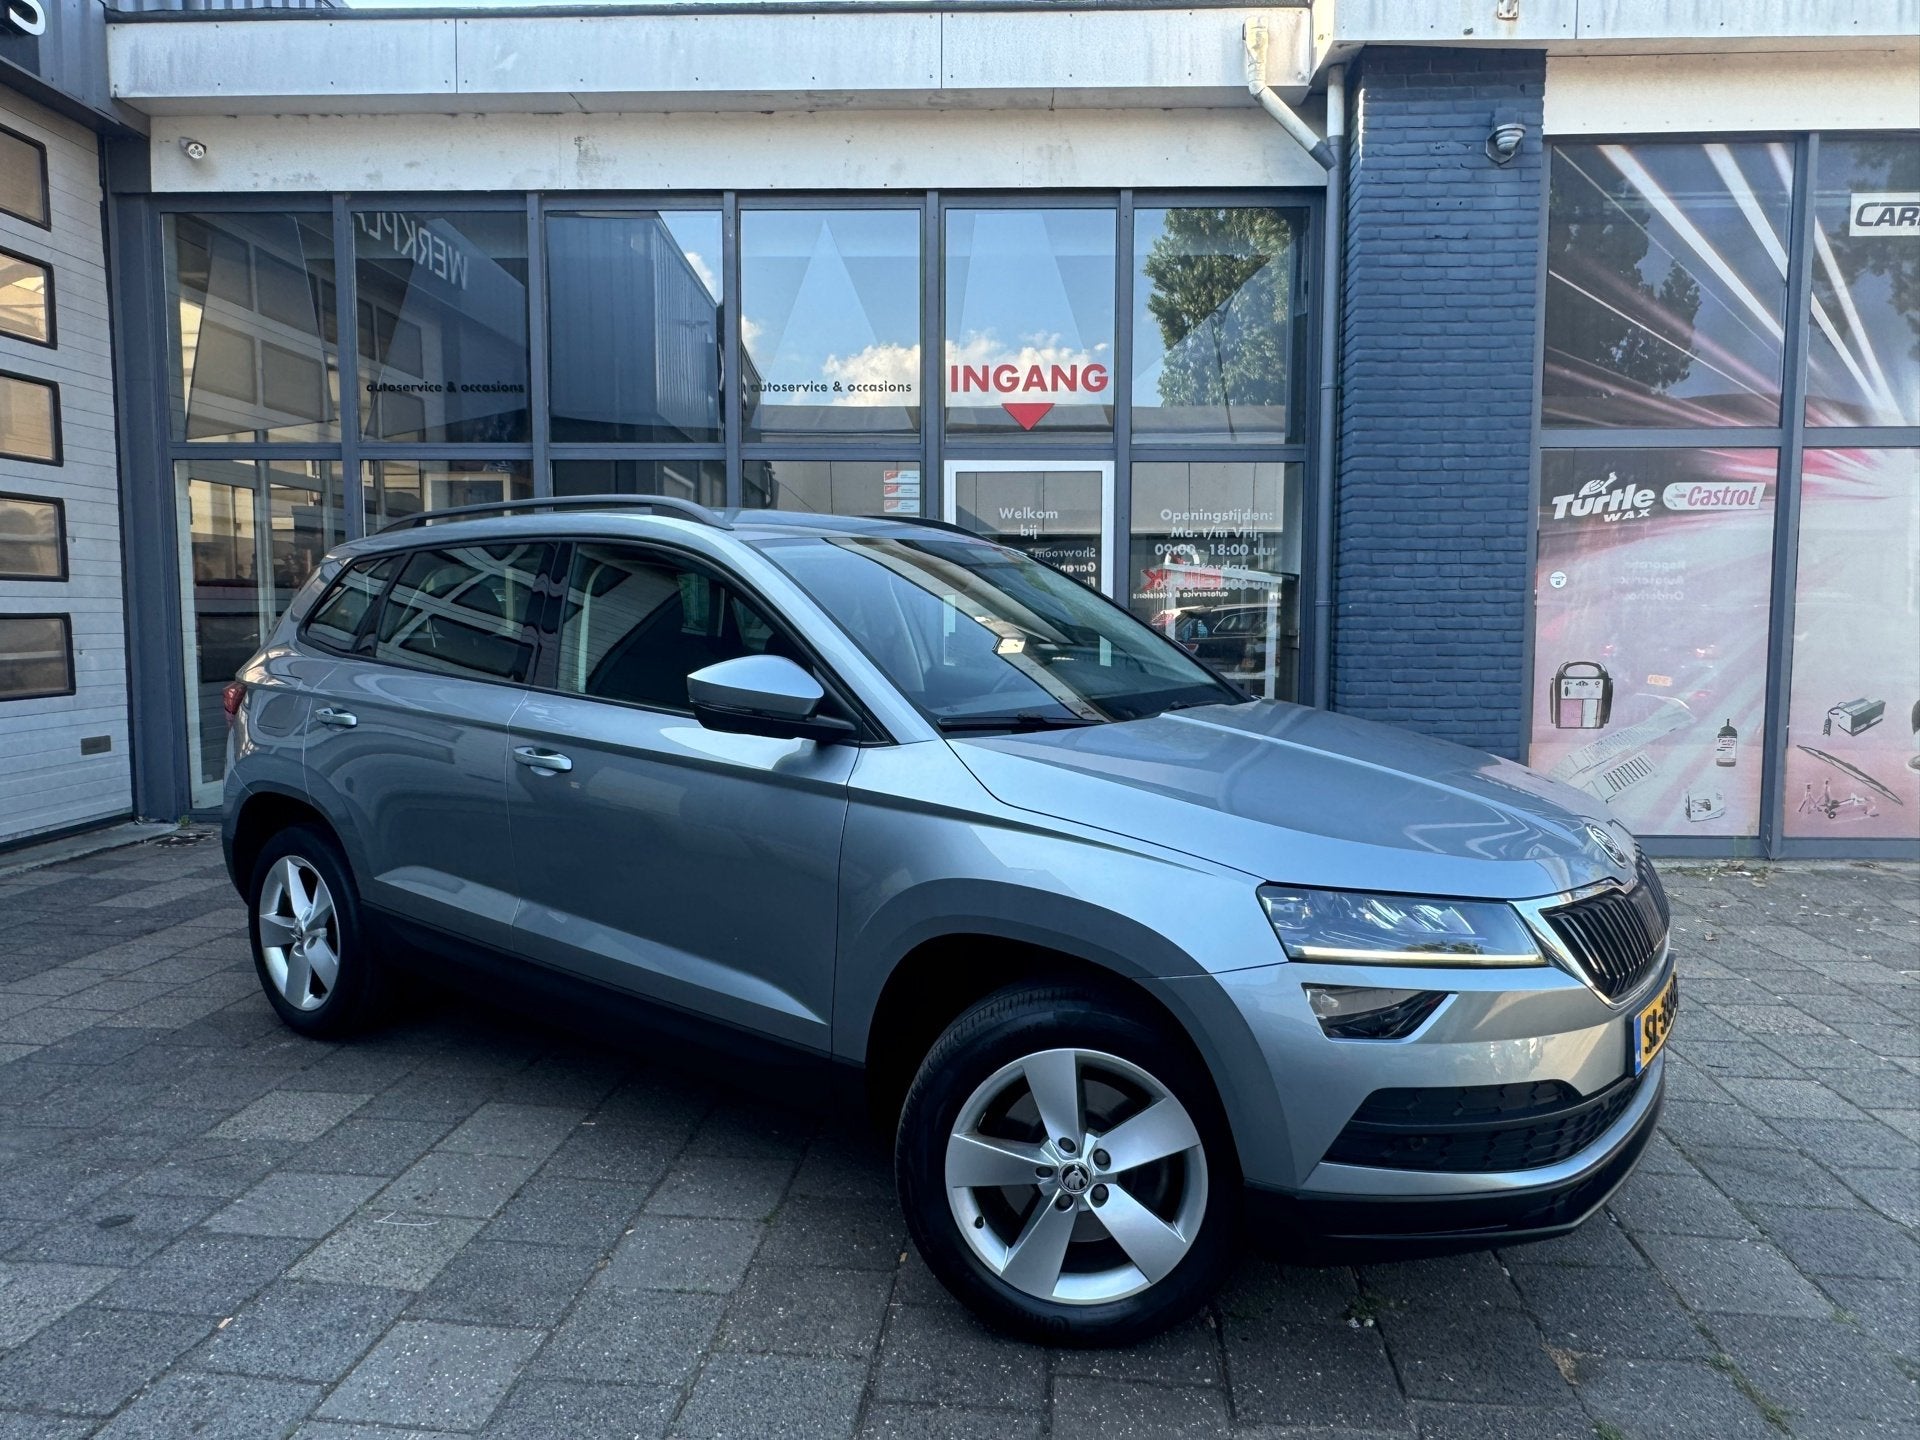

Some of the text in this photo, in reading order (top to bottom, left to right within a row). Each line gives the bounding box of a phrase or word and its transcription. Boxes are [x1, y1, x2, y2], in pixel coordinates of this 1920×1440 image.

[1855, 201, 1920, 227] CAR
[950, 363, 1109, 394] INGANG
[366, 380, 525, 393] autoservice & occasions
[750, 380, 912, 393] autoservice & occasions
[1552, 483, 1655, 520] Turtle
[1687, 485, 1758, 507] Castrol
[999, 507, 1058, 519] Welkom
[1160, 508, 1273, 524] Openingstijden:
[1603, 508, 1650, 522] WAX
[1020, 524, 1037, 539] bij
[1171, 527, 1198, 538] Ma.
[1202, 526, 1228, 540] t/m
[1154, 544, 1196, 556] 09:00
[1209, 544, 1249, 556] 18:00
[1253, 546, 1277, 556] uur
